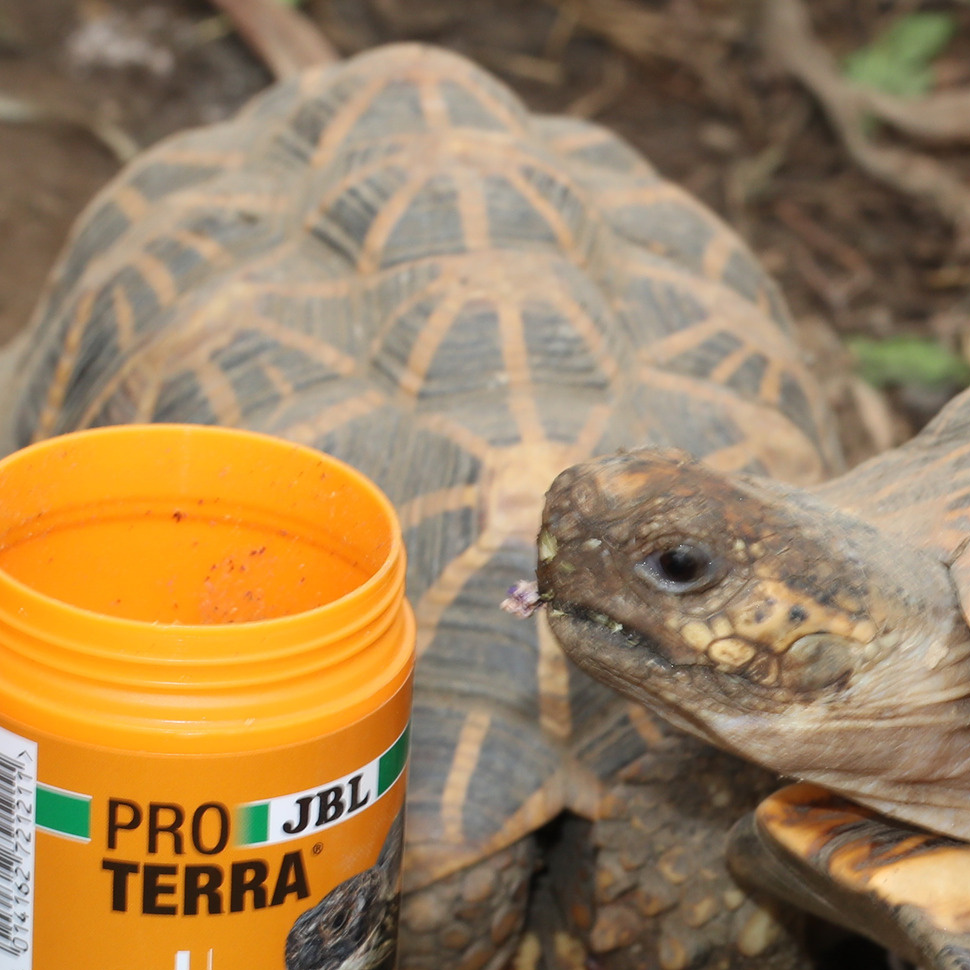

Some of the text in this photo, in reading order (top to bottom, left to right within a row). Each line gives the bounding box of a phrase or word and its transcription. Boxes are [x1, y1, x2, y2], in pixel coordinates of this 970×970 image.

[15, 770, 33, 855] 721211
[106, 797, 231, 855] PRO
[283, 773, 371, 834] JBL
[12, 867, 31, 952] 014162
